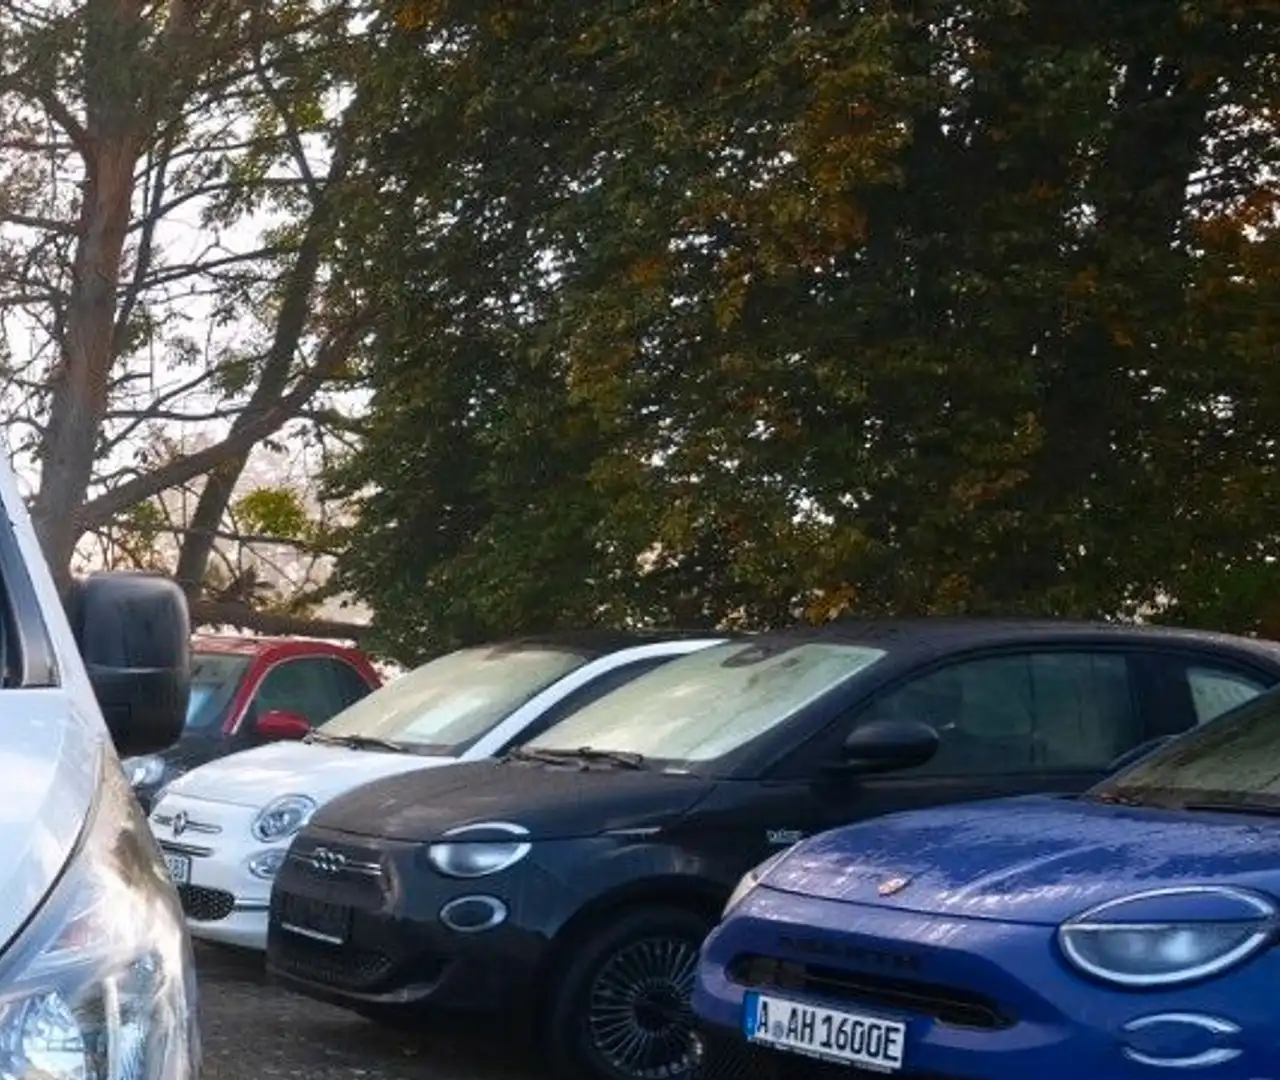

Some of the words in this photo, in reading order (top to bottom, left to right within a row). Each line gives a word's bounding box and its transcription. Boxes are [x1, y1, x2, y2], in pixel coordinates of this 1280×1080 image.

[757, 1000, 769, 1034] A
[786, 1007, 816, 1045] AH
[820, 1014, 901, 1062] 1600E
